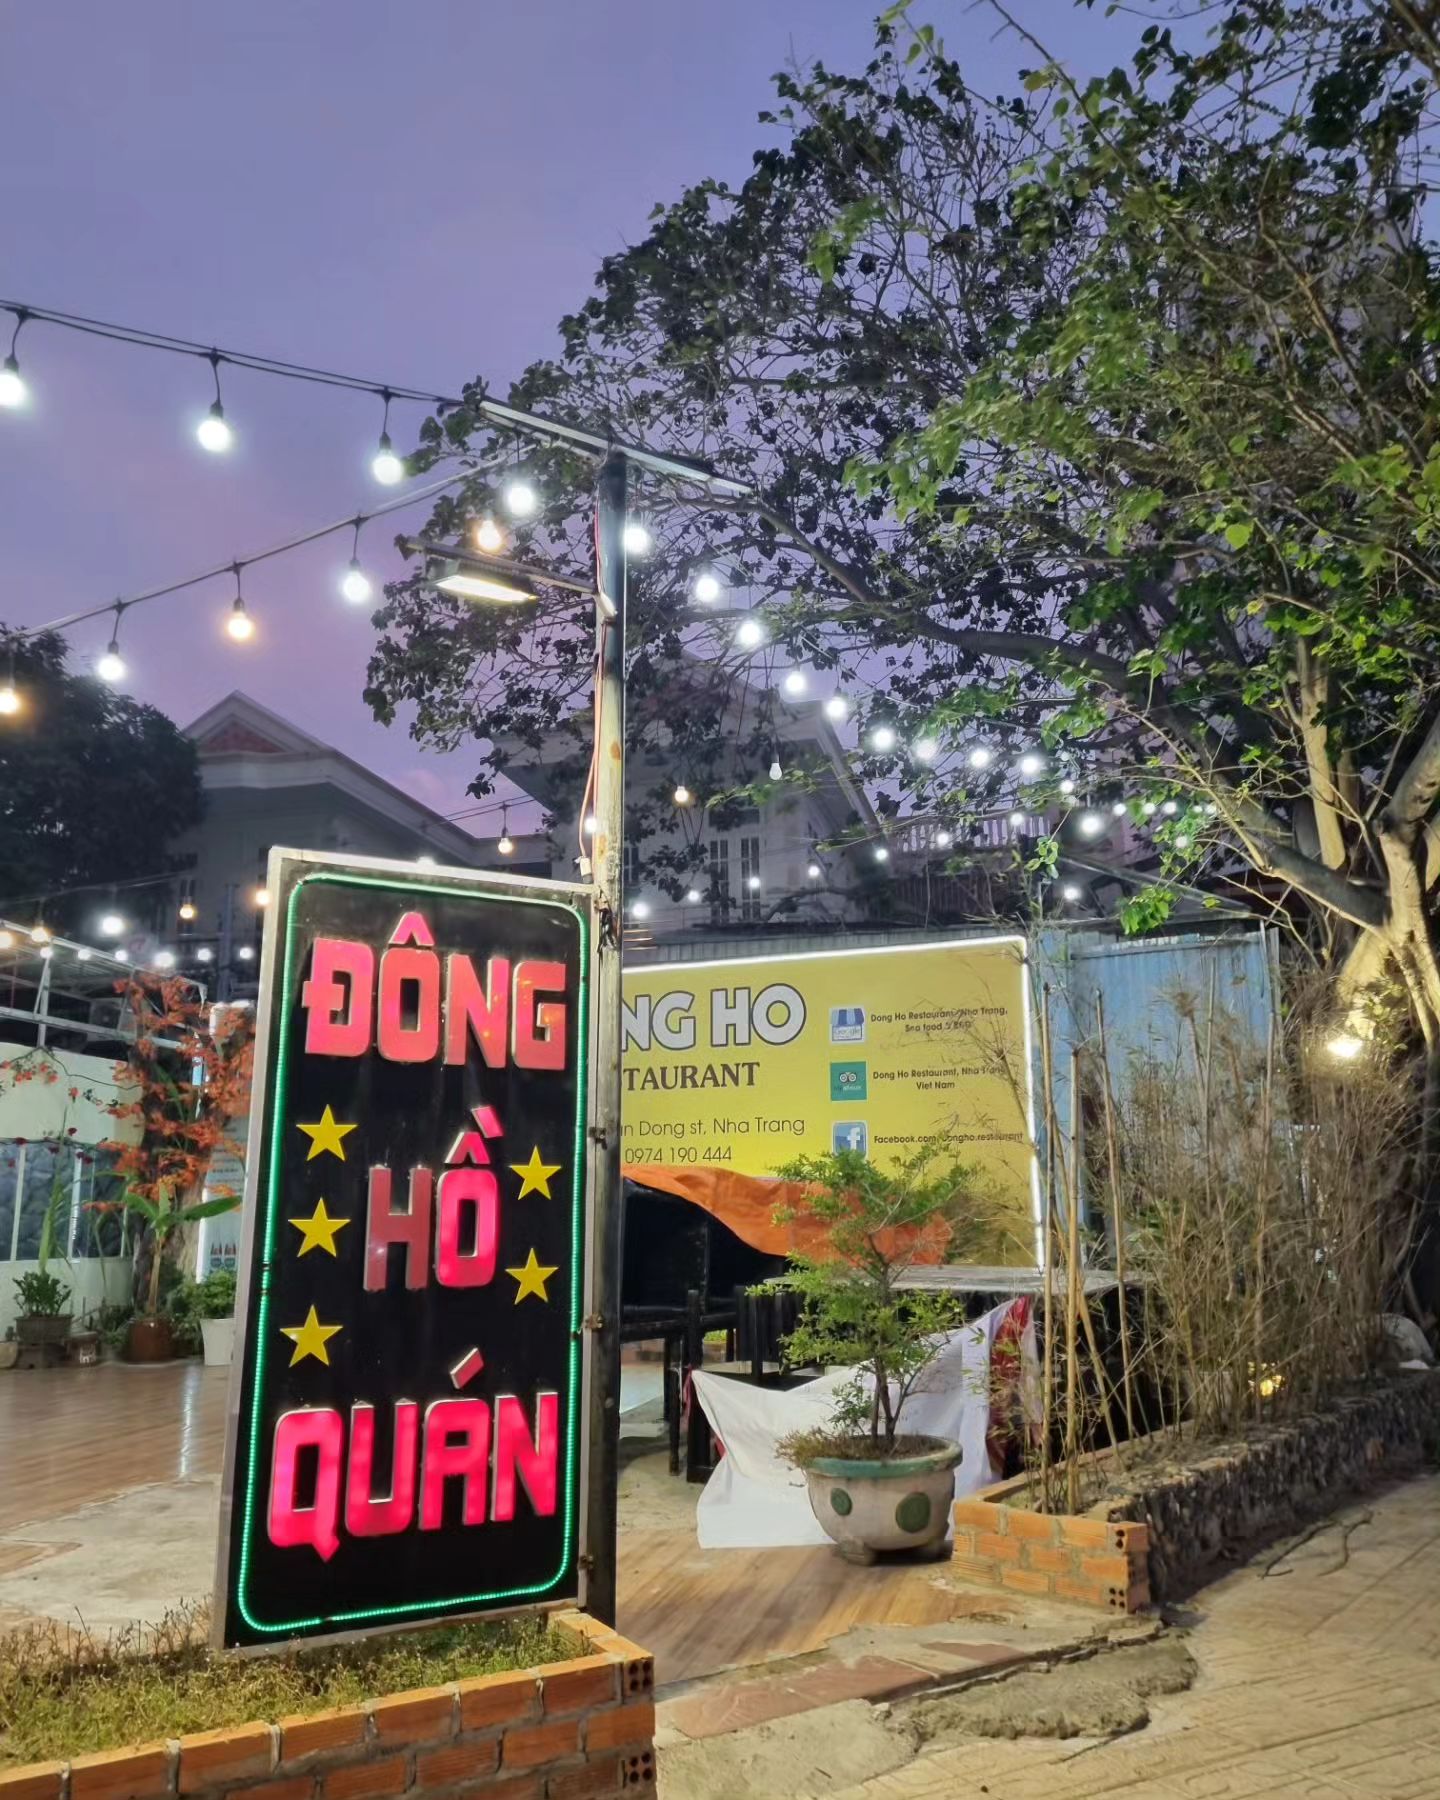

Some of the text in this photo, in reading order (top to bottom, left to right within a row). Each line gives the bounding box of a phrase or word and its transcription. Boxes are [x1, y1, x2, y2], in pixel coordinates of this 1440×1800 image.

[302, 911, 569, 1071] ĐÔNG
[711, 983, 806, 1046] HO
[870, 1014, 893, 1023] Dong
[894, 1012, 906, 1021] Ho
[923, 1022, 943, 1031] food
[873, 1071, 895, 1081] Dong
[897, 1070, 910, 1079] Ho
[916, 1081, 955, 1090] Viet Nam
[639, 1121, 685, 1139] Dong
[690, 1120, 707, 1135] st,
[713, 1118, 750, 1135] Nha
[754, 1116, 806, 1136] Trang
[625, 1146, 732, 1163] 0974 190 444
[363, 1105, 505, 1293] HỒ
[267, 1347, 560, 1563] QUÁN
